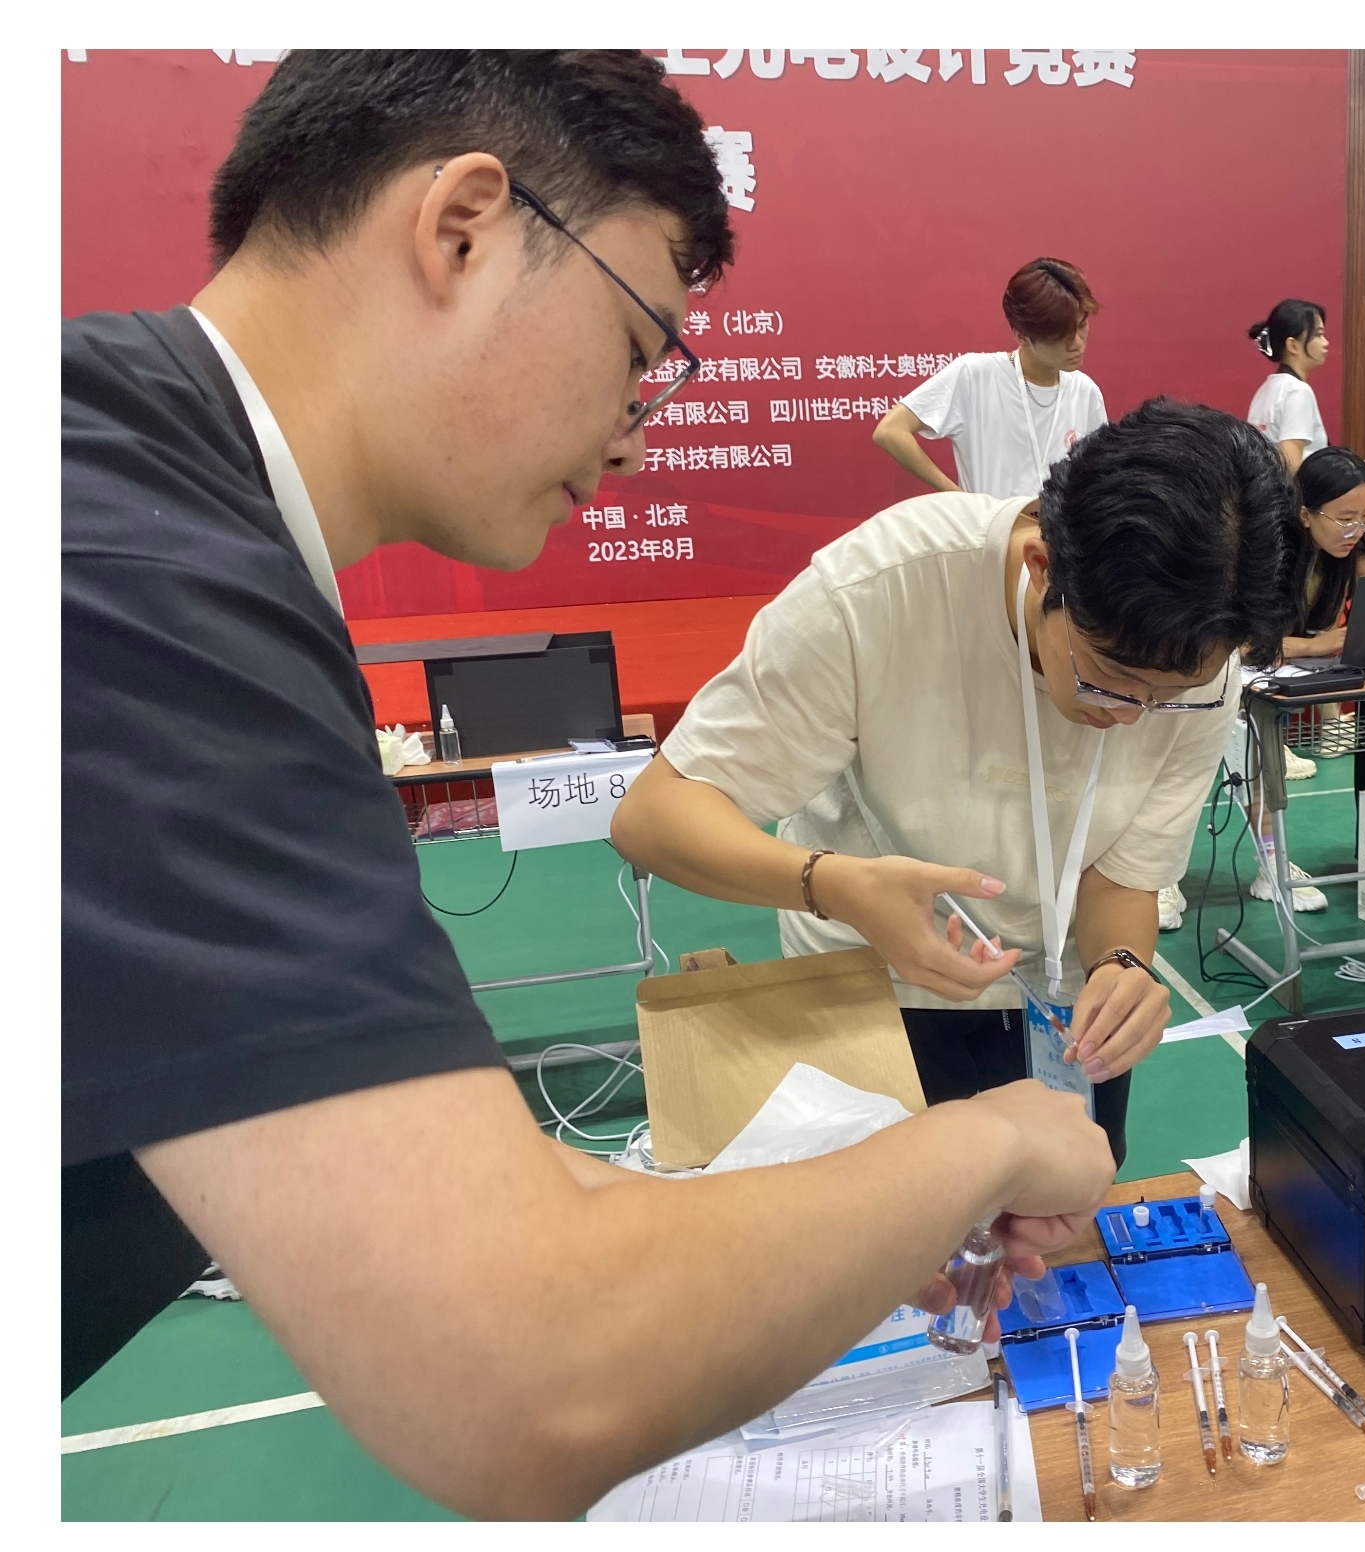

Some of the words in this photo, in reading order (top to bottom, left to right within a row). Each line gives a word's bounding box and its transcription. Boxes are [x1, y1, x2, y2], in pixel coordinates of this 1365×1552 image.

[815, 352, 963, 381] 安徽科大奥锐科
[638, 443, 793, 472] 子科技有限公司
[587, 537, 694, 562] 2023年8月
[528, 772, 599, 809] 场地
[609, 773, 626, 799] 8
